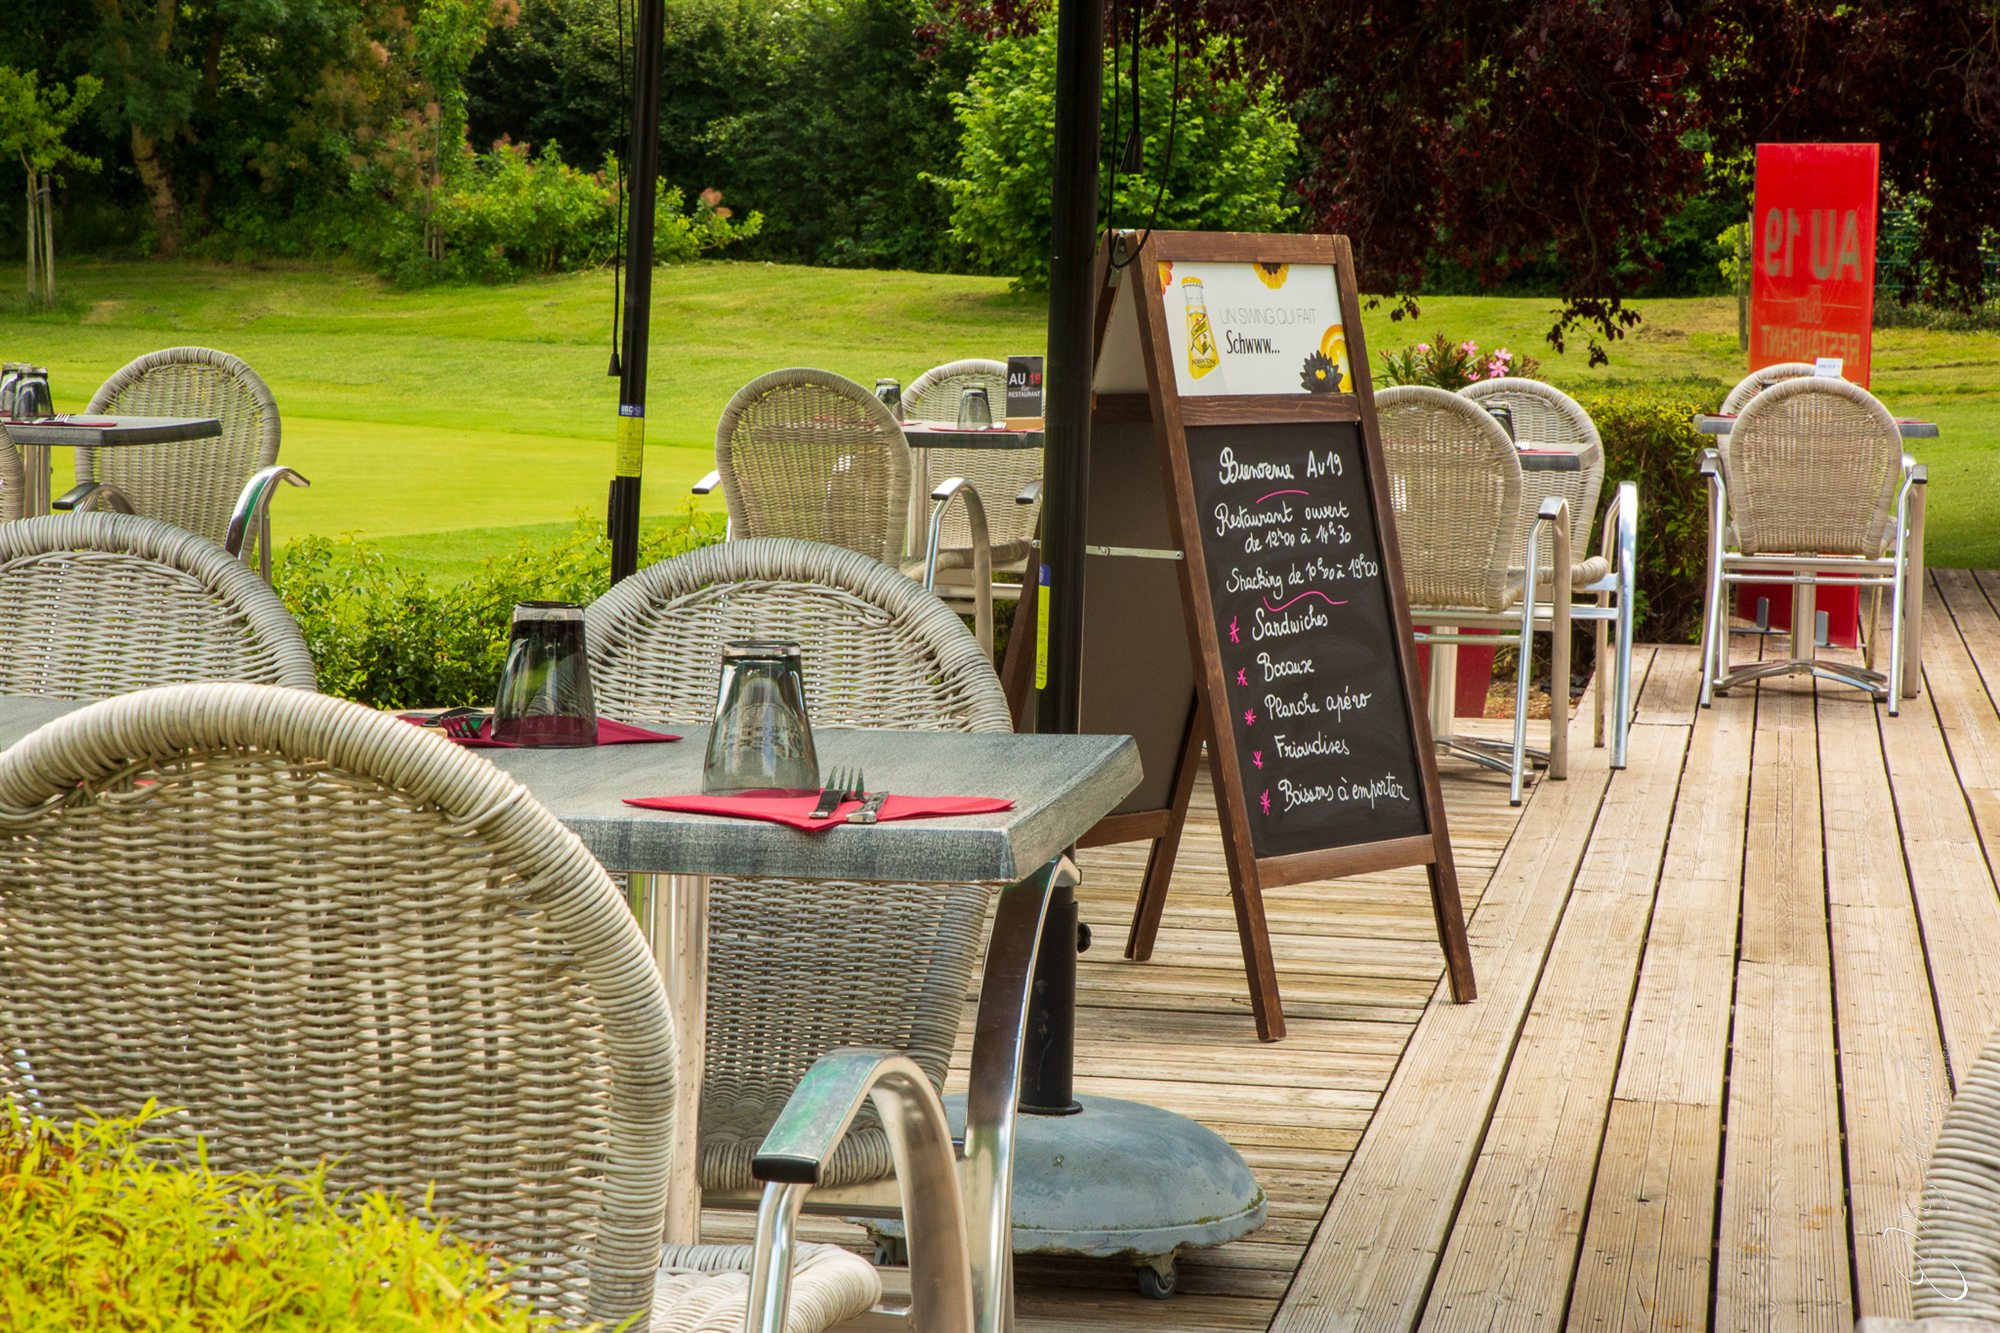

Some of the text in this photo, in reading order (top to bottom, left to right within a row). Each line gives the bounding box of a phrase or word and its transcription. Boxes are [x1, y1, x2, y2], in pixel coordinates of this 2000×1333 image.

[1220, 307, 1316, 326] UN SWING QUI FAIT
[1008, 372, 1042, 386] AU 19
[1214, 500, 1350, 536] Restaurant ouvert
[1245, 532, 1263, 554] de
[1300, 527, 1311, 545] à
[1226, 567, 1284, 601] Snacking
[1288, 563, 1305, 585] de
[1252, 604, 1328, 641] Sandwiches
[1256, 652, 1315, 682] Bocaux
[1264, 685, 1372, 723] Planche apéro
[1274, 731, 1350, 759] Friandises
[1277, 772, 1410, 812] Boissons à emporter
